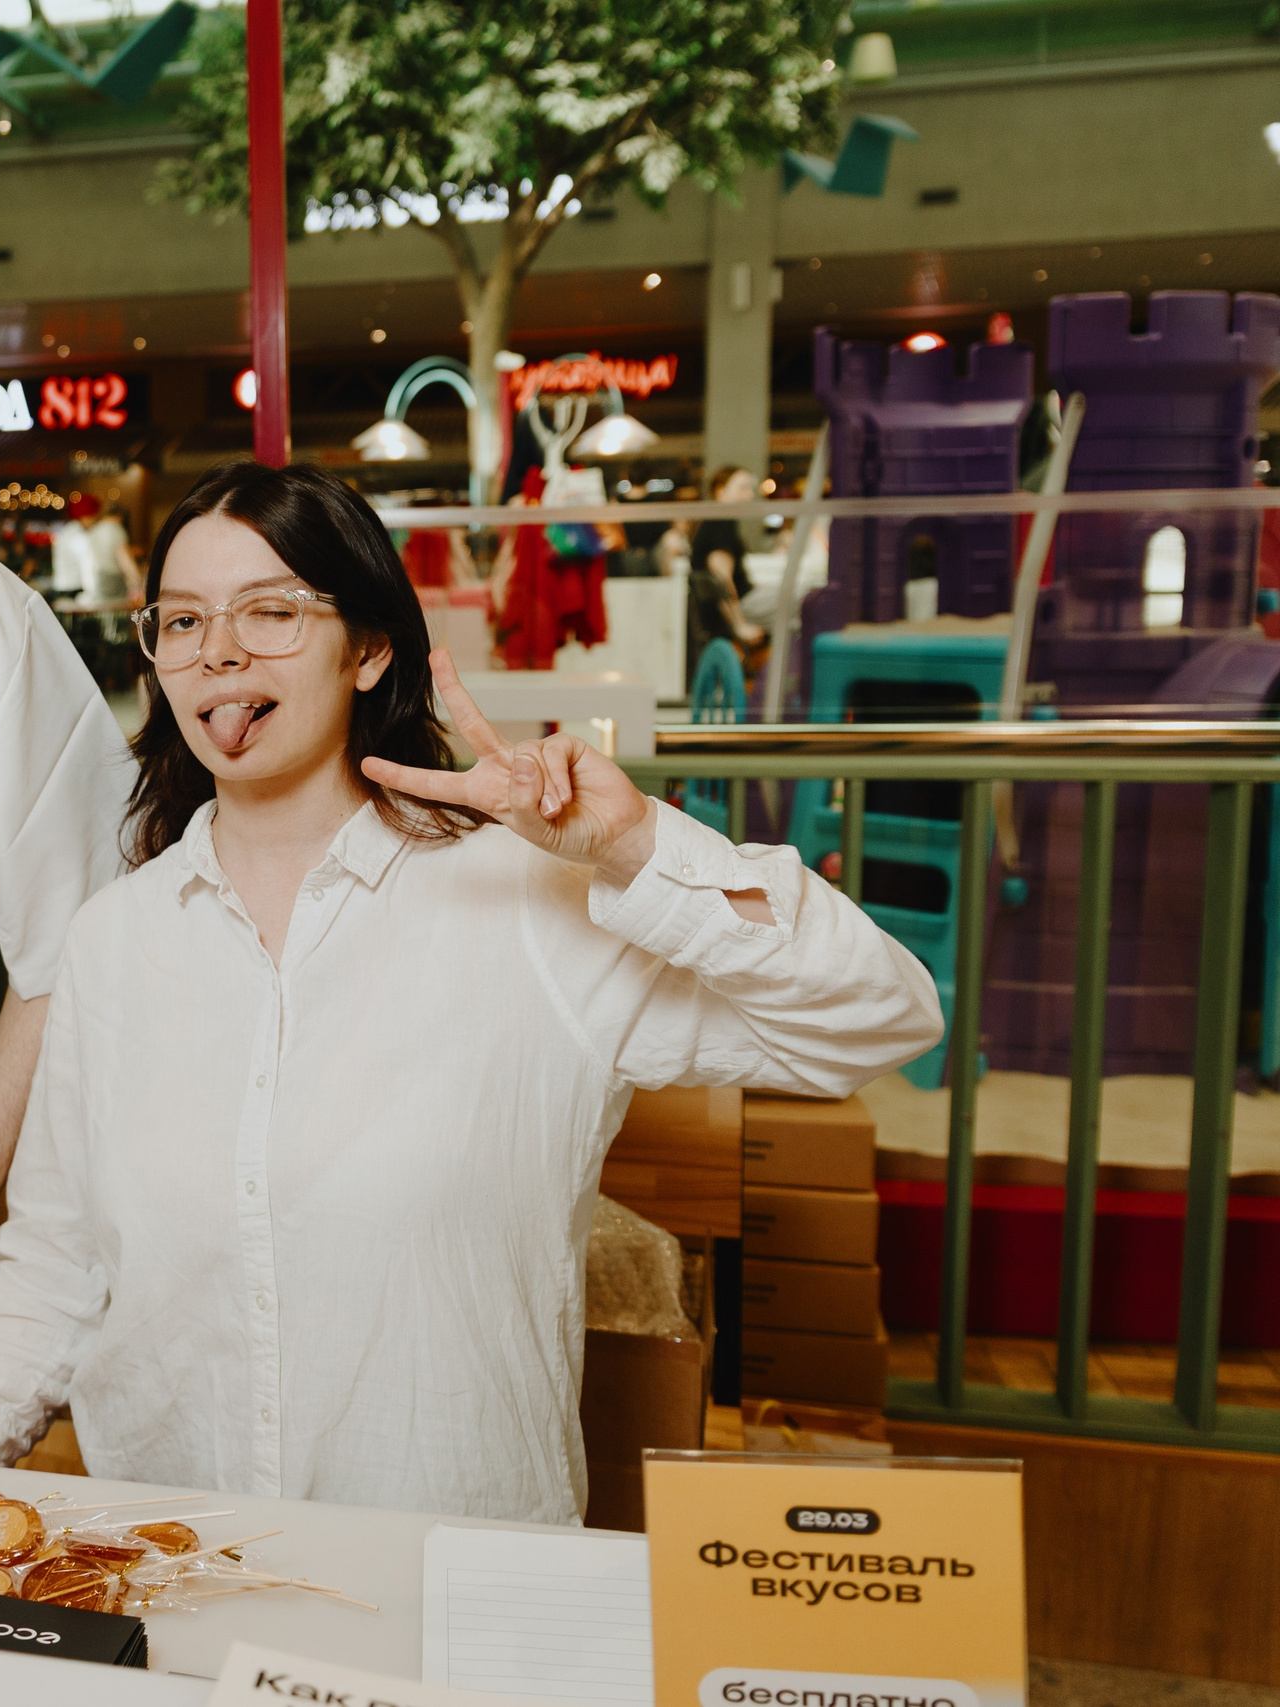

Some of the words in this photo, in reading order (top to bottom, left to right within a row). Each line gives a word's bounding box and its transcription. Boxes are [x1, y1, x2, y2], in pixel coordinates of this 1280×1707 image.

[38, 373, 127, 430] 812
[797, 1510, 870, 1530] 29.03
[698, 1540, 976, 1578] Фестиваль
[751, 1577, 923, 1606] вкусов
[254, 1670, 352, 1707] Как
